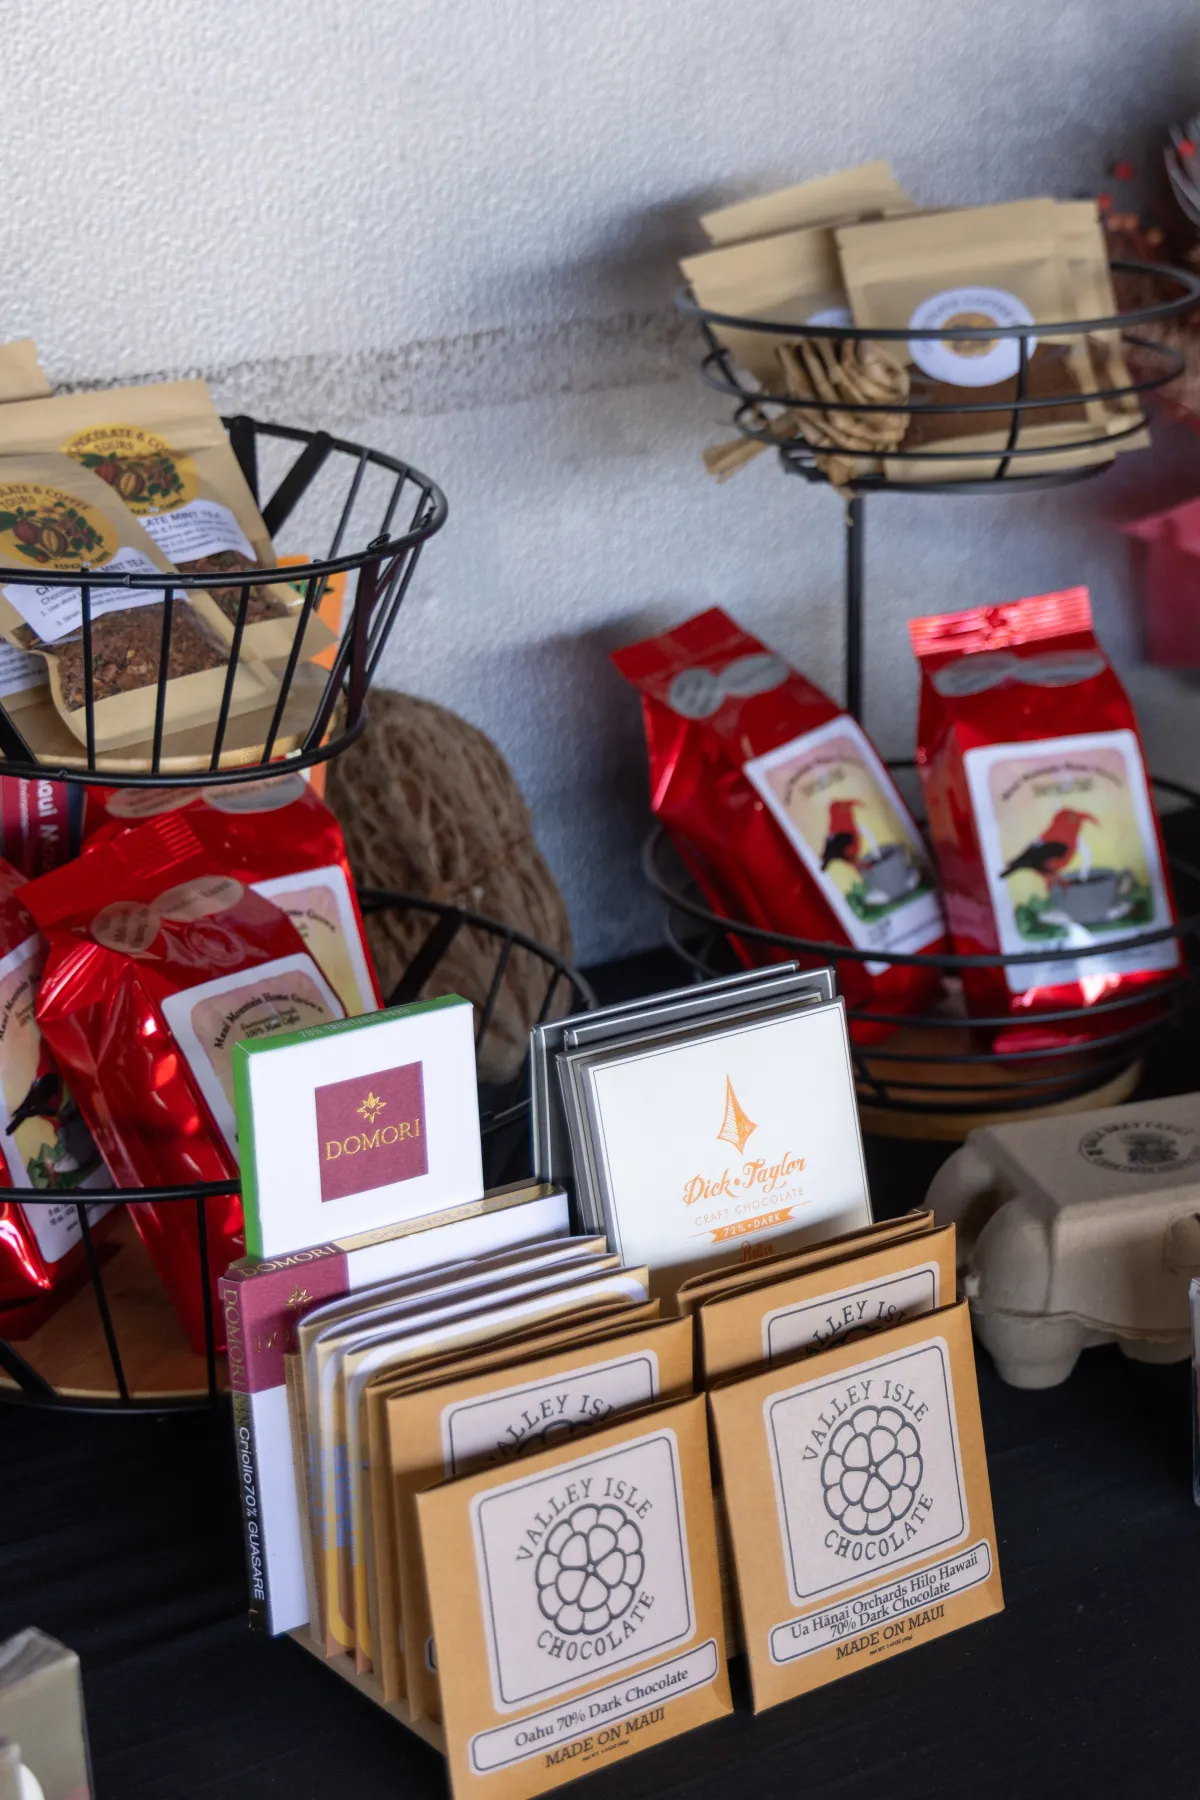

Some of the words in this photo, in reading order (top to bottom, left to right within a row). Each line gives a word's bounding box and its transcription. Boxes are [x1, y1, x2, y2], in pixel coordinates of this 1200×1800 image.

[325, 1118, 421, 1162] DOMORI
[682, 1167, 740, 1207] Dick
[742, 1150, 807, 1194] Taylor
[694, 1208, 731, 1227] CRAFT
[734, 1186, 805, 1216] CHOCOLATE
[723, 1223, 747, 1238] 72%
[753, 1212, 782, 1229] DARK
[239, 1245, 337, 1278] DOMORI
[223, 1288, 247, 1387] DOMORI
[803, 1299, 869, 1356] ALLEY
[490, 1393, 570, 1461] ALLEY
[802, 1379, 874, 1462] VALLEY
[883, 1379, 930, 1423] ISLE
[515, 1476, 594, 1562] VALLEY
[603, 1477, 653, 1520] ISLE
[823, 1492, 935, 1562] CHOCOLATE
[247, 1520, 266, 1601] GUASARE
[536, 1591, 656, 1662] CHOCOLATE
[790, 1623, 810, 1640] Ua
[811, 1605, 851, 1632] Hānai
[852, 1583, 908, 1616] Orchards
[910, 1573, 937, 1593] Hilo
[938, 1551, 979, 1581] Hawaii
[829, 1617, 858, 1639] 70%
[858, 1604, 890, 1629] Dark
[892, 1581, 951, 1613] Chocolate
[835, 1632, 881, 1661] MADE
[883, 1622, 905, 1641] ON
[908, 1603, 946, 1632] MAUI
[514, 1722, 555, 1748] Oahu
[556, 1708, 586, 1732] 70%
[588, 1694, 623, 1719] Dark
[624, 1668, 689, 1702] Chocolate
[544, 1735, 594, 1769] MADE
[596, 1724, 622, 1746] ON
[624, 1706, 666, 1736] MAUI
